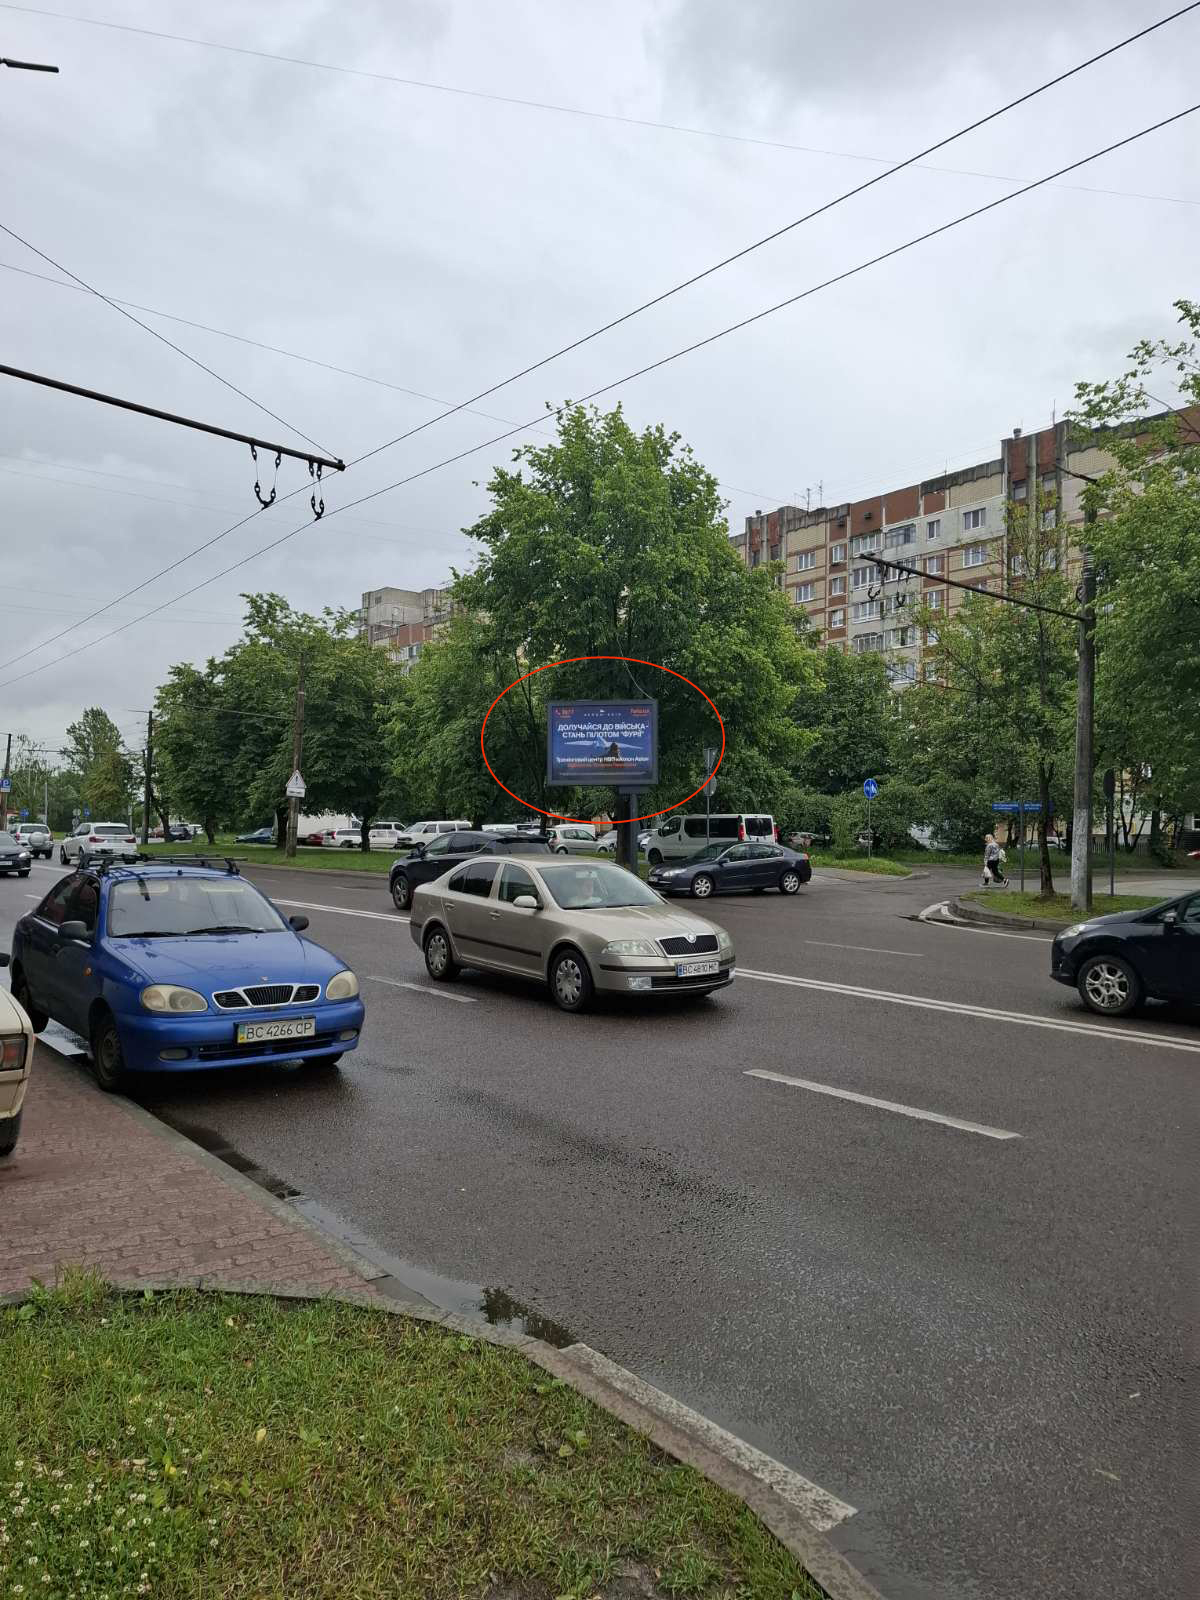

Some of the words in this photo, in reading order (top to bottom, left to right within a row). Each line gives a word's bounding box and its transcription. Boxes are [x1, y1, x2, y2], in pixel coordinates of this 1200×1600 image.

[558, 722, 602, 732] ДОЛУЧАЙСЯ
[614, 722, 645, 730] ВІЙСЬКА
[266, 1024, 293, 1037] 4266
